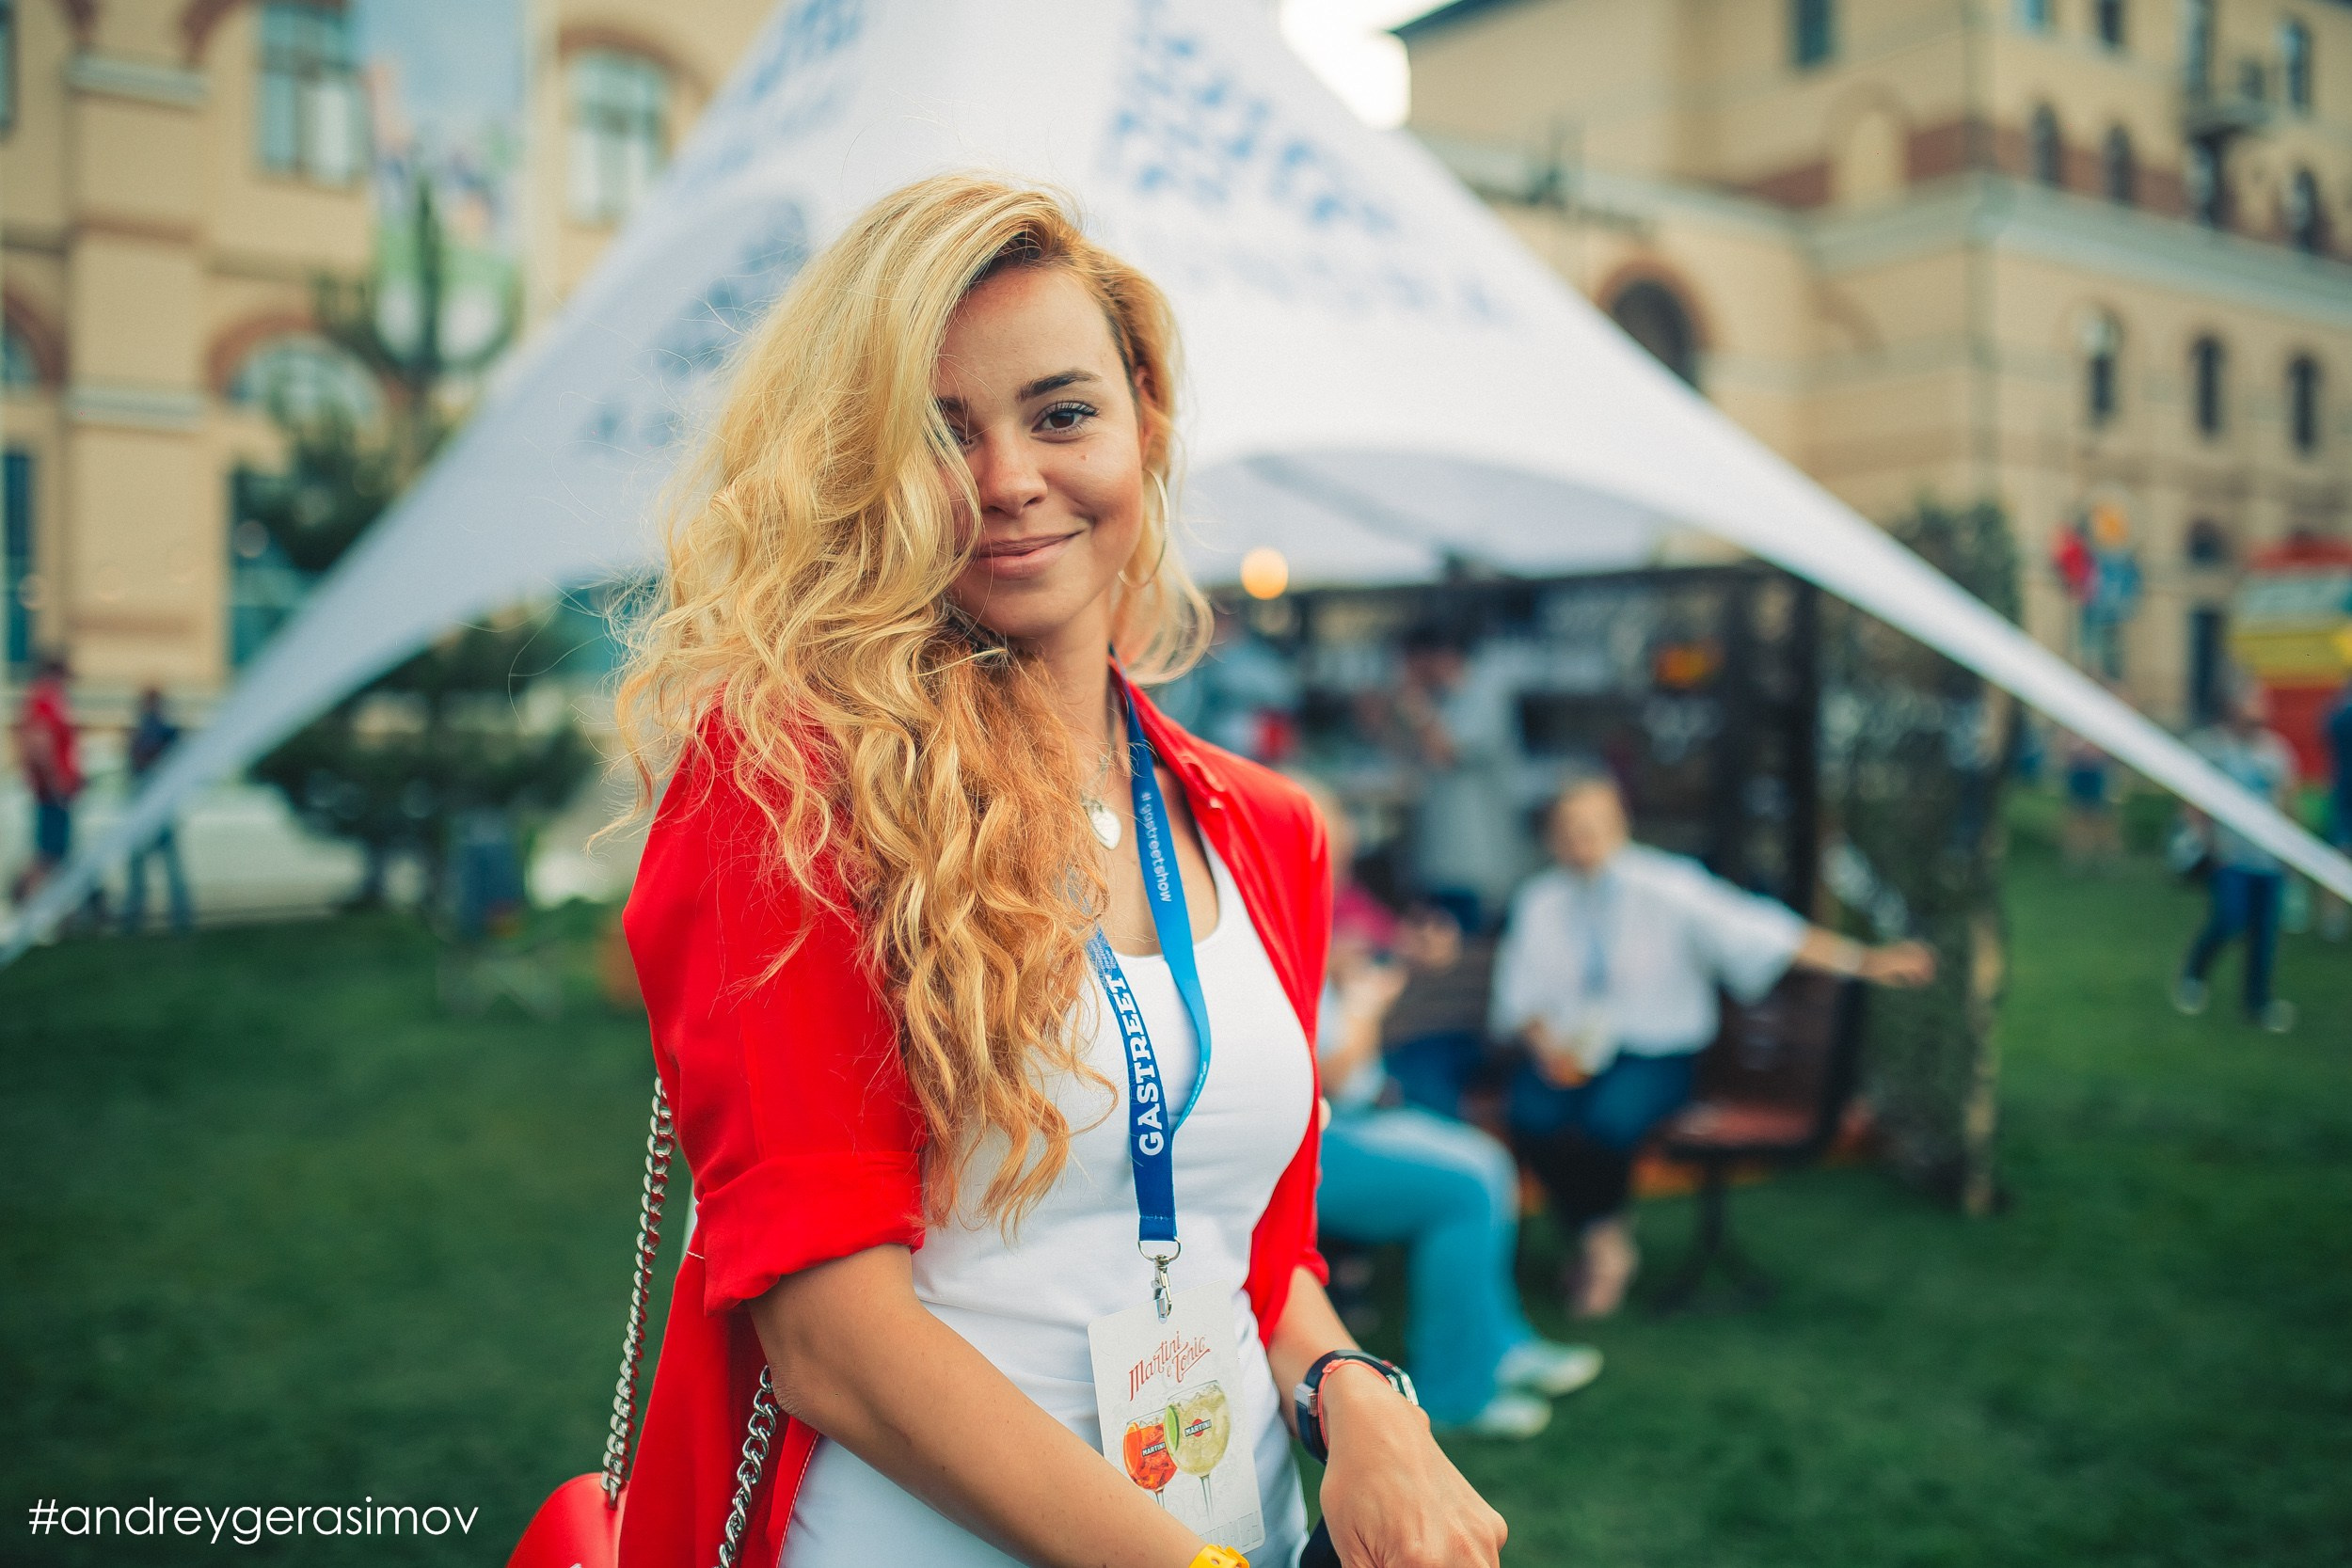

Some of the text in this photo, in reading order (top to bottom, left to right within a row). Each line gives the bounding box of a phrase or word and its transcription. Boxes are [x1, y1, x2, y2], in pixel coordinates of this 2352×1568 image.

[1104, 974, 1165, 1156] GASTREET
[1129, 1330, 1180, 1402] Martini
[1172, 1336, 1210, 1384] Tonic
[1142, 1442, 1166, 1457] MARTINI
[1184, 1419, 1212, 1436] MARTINI
